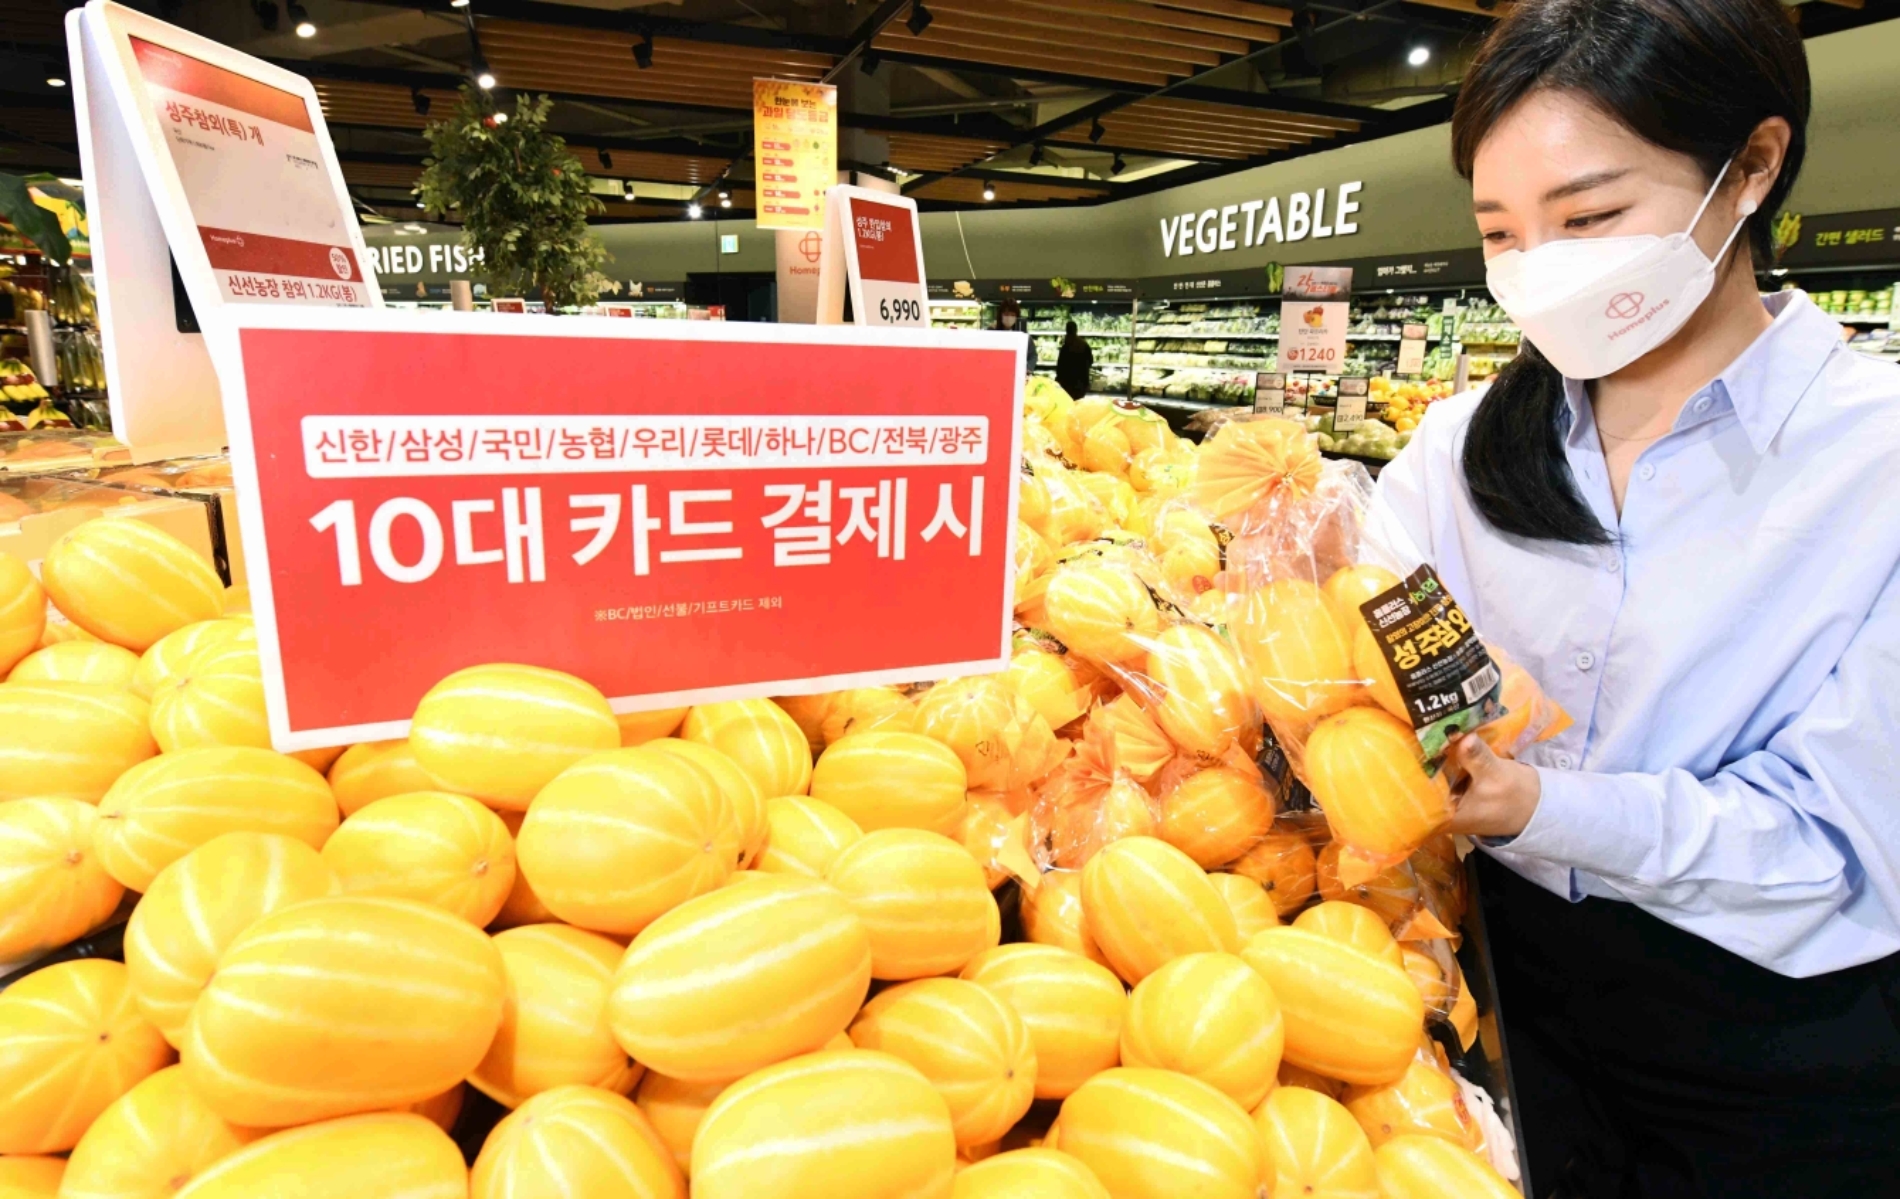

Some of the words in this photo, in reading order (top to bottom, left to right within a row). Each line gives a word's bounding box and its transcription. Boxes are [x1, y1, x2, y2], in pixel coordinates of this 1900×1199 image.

[166, 100, 248, 141] 성주참외(특)
[248, 125, 265, 147] 개
[1160, 181, 1362, 258] VEGETABLE
[228, 274, 280, 299] 신선농장
[281, 279, 307, 300] 참외
[306, 282, 357, 303] 1.2KG(봉)
[880, 298, 921, 324] 6,990
[1607, 298, 1671, 341] Homeplus
[308, 487, 546, 586] 10대
[568, 484, 743, 577] 카드
[760, 477, 908, 567] 결제
[919, 475, 985, 557] 시
[757, 596, 782, 609] 제외
[1414, 691, 1460, 714] 1.2kg
